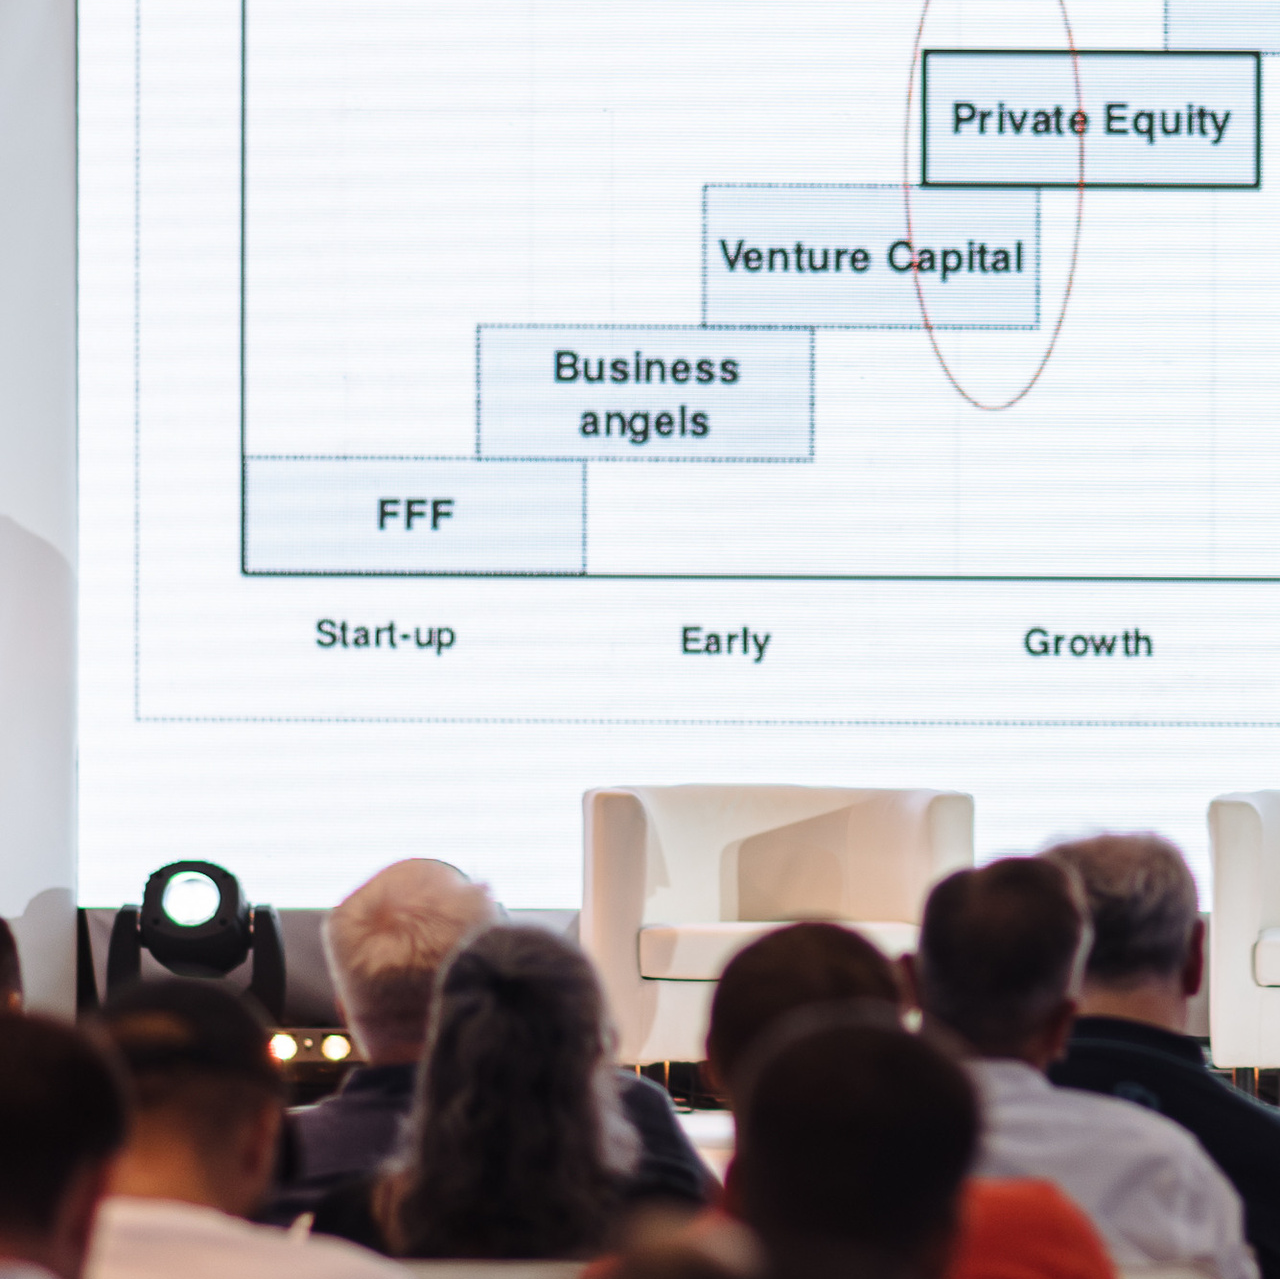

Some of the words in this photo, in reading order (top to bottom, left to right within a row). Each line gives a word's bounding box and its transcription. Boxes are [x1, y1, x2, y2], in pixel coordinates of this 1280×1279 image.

[952, 101, 1090, 138] Private
[1103, 101, 1233, 146] Equity
[718, 238, 872, 275] Venture
[886, 238, 1025, 282] Capital
[553, 349, 741, 386] Business
[578, 404, 711, 446] angels
[376, 498, 456, 532] FFF
[315, 618, 457, 657] Start-up
[681, 625, 772, 664] Early
[1023, 626, 1154, 659] Growth
